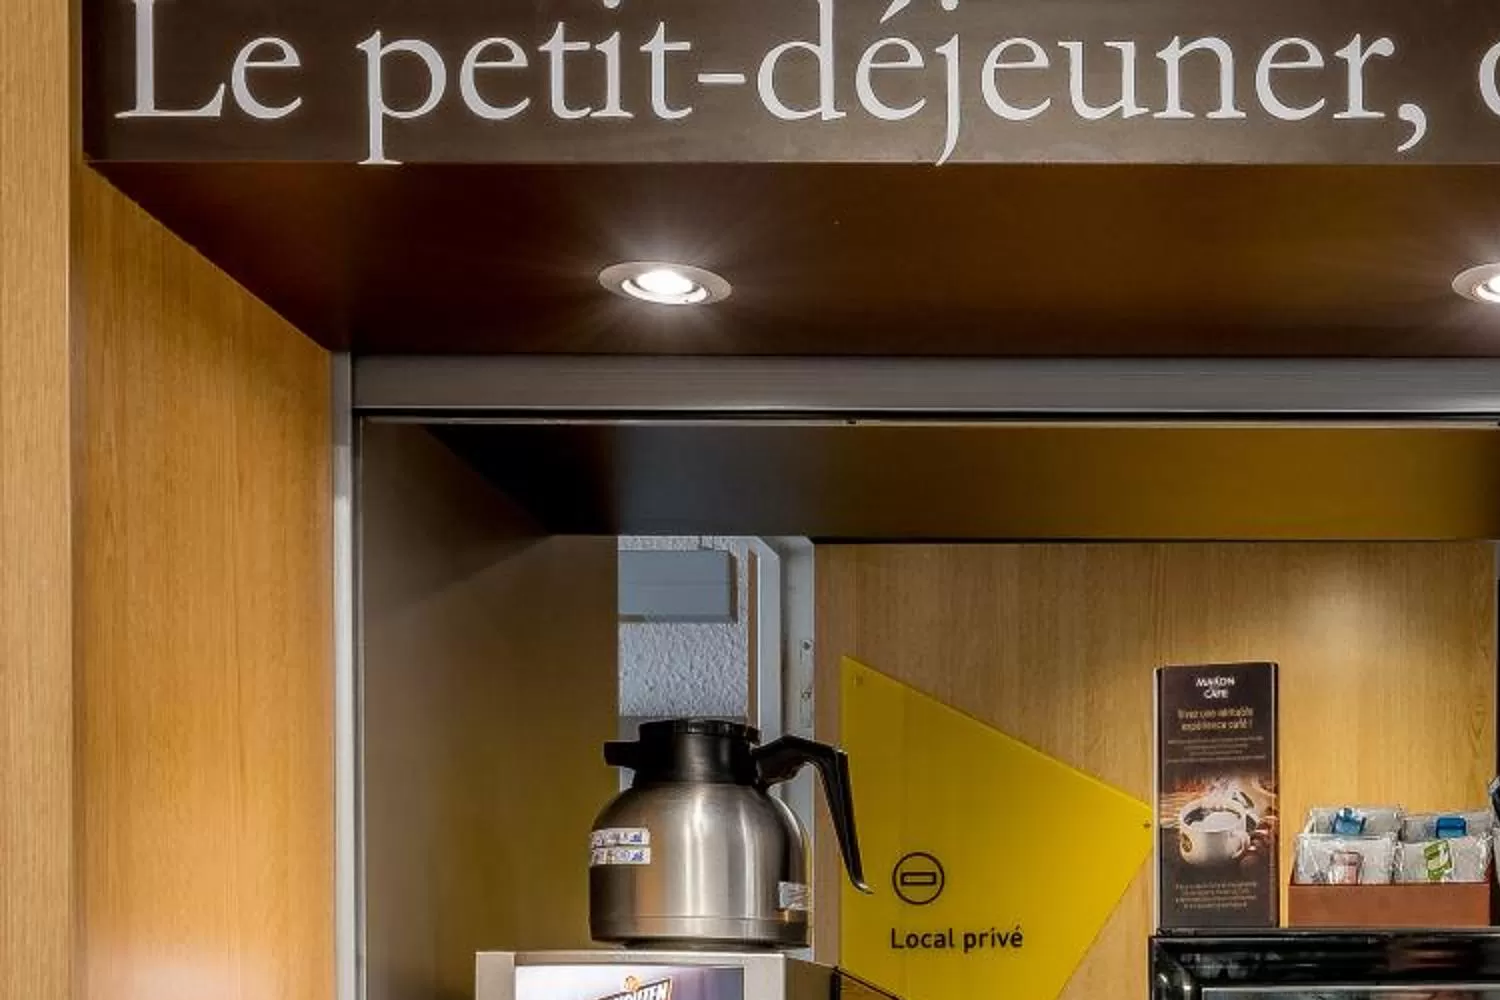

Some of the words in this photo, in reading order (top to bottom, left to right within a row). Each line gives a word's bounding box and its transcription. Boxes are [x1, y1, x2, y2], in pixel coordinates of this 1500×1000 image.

[114, 0, 302, 120] Le
[356, 0, 1428, 167] petit-déjeuner,
[891, 927, 955, 949] Local
[963, 924, 1024, 953] privé
